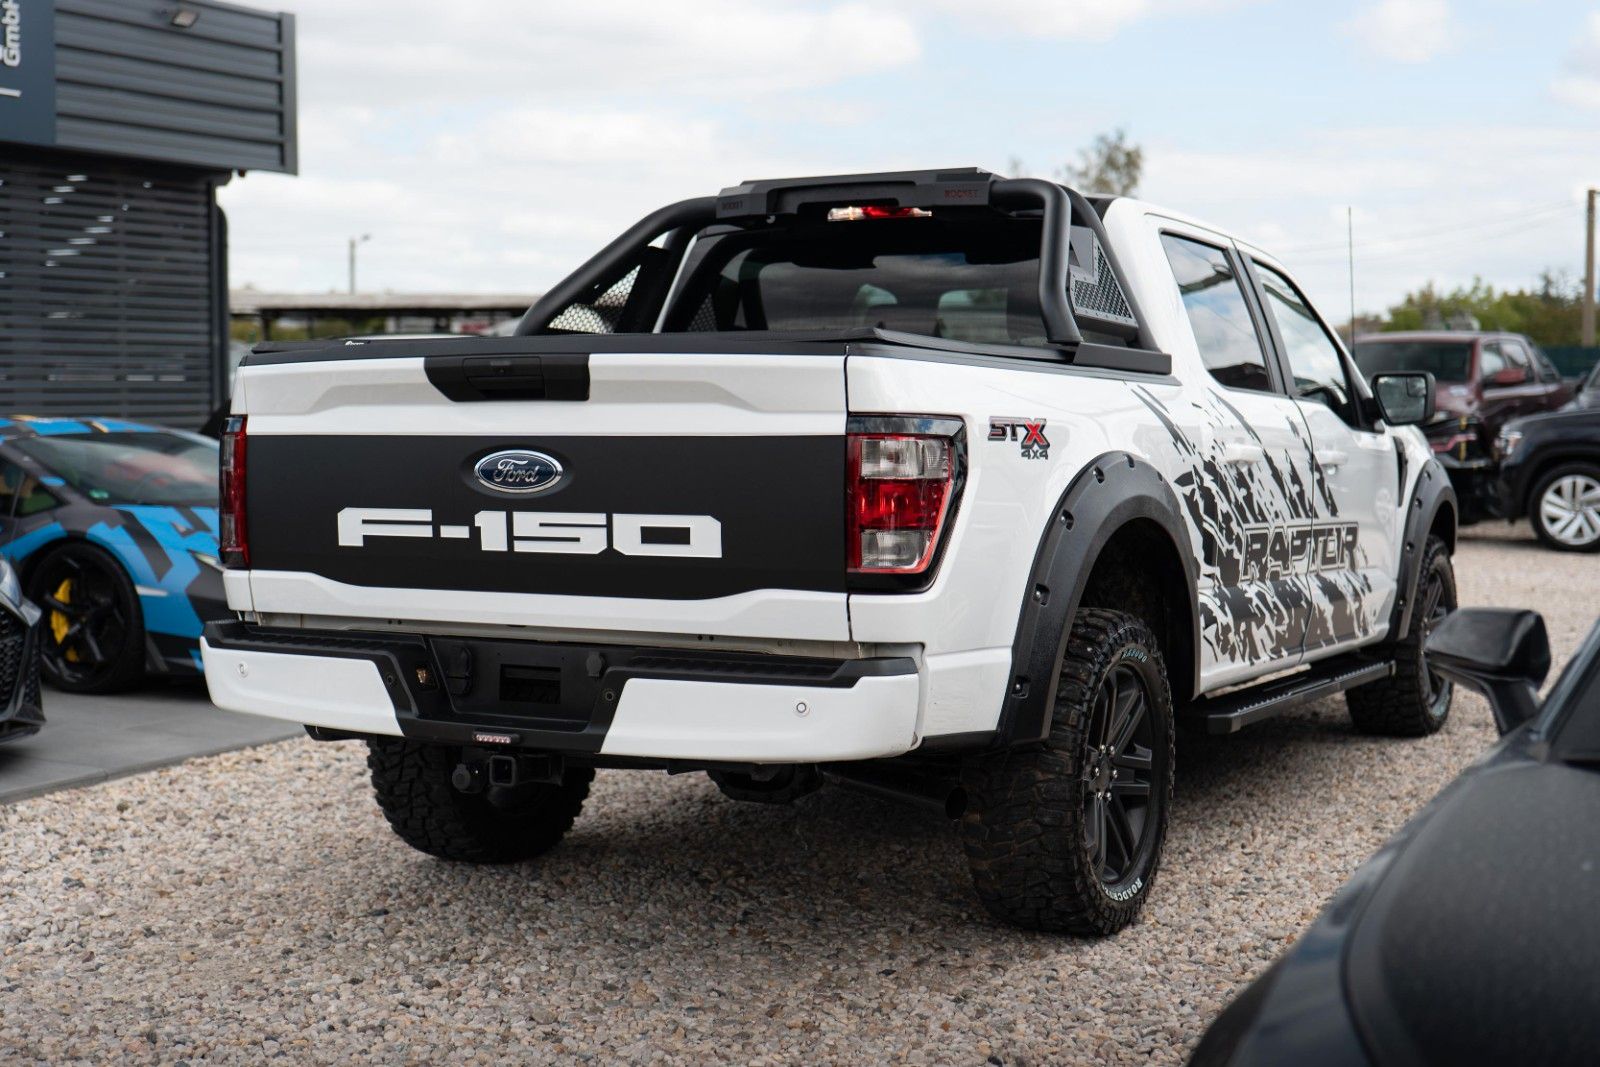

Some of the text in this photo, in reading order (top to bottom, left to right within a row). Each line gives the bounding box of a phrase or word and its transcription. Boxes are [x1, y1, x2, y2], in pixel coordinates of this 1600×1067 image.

[988, 416, 1050, 450] STX
[493, 458, 540, 482] Ford
[337, 507, 722, 558] F-150
[1240, 522, 1358, 580] RAPTOR
